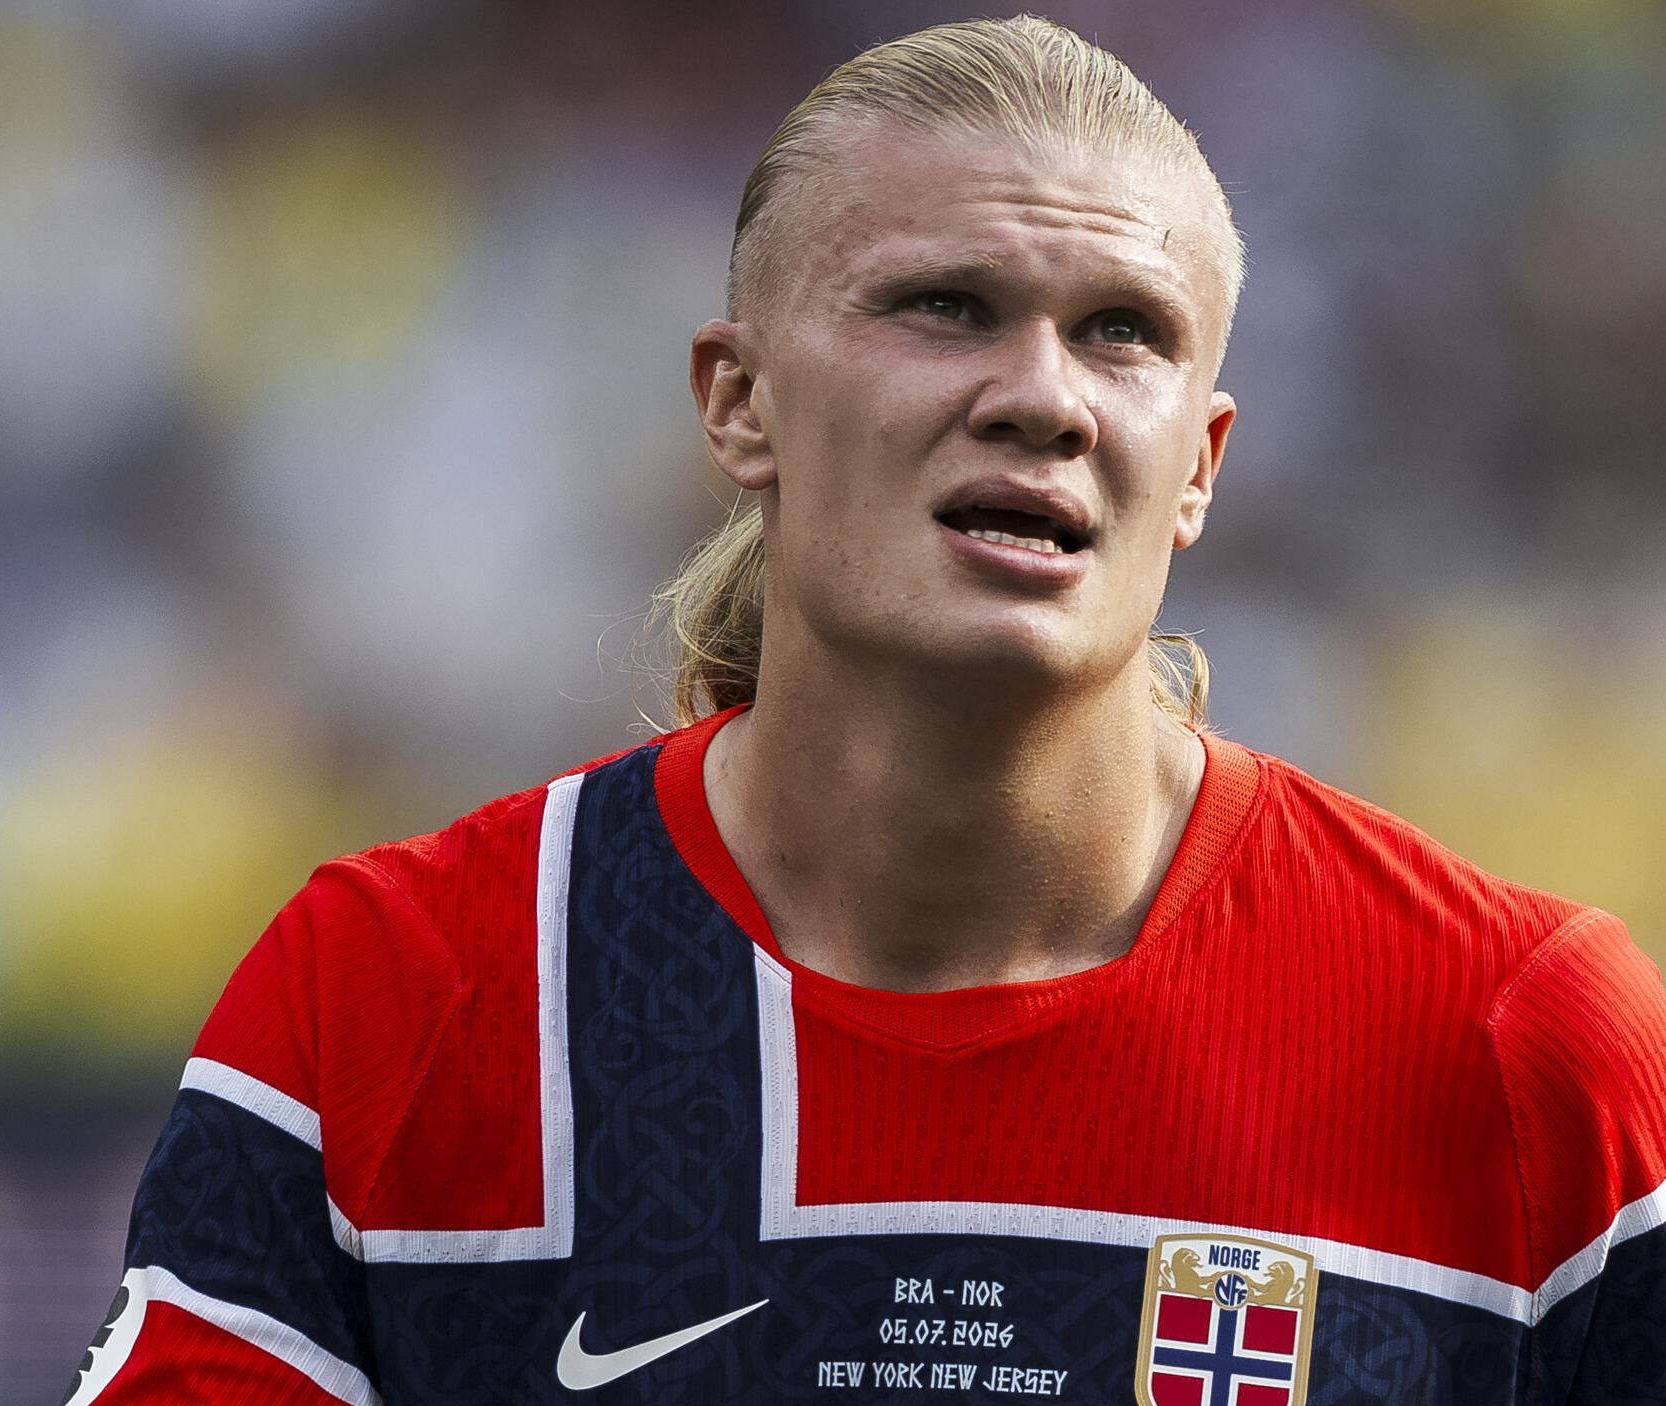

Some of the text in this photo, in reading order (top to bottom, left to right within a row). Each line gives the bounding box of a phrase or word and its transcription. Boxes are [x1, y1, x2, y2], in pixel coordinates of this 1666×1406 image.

[1208, 1244, 1261, 1271] NORGE
[894, 1278, 935, 1304] BRA
[961, 1280, 1005, 1307] NOR
[879, 1318, 1014, 1348] 05.07.2026
[817, 1360, 1069, 1396] NEW YORK NEW JERSEY
